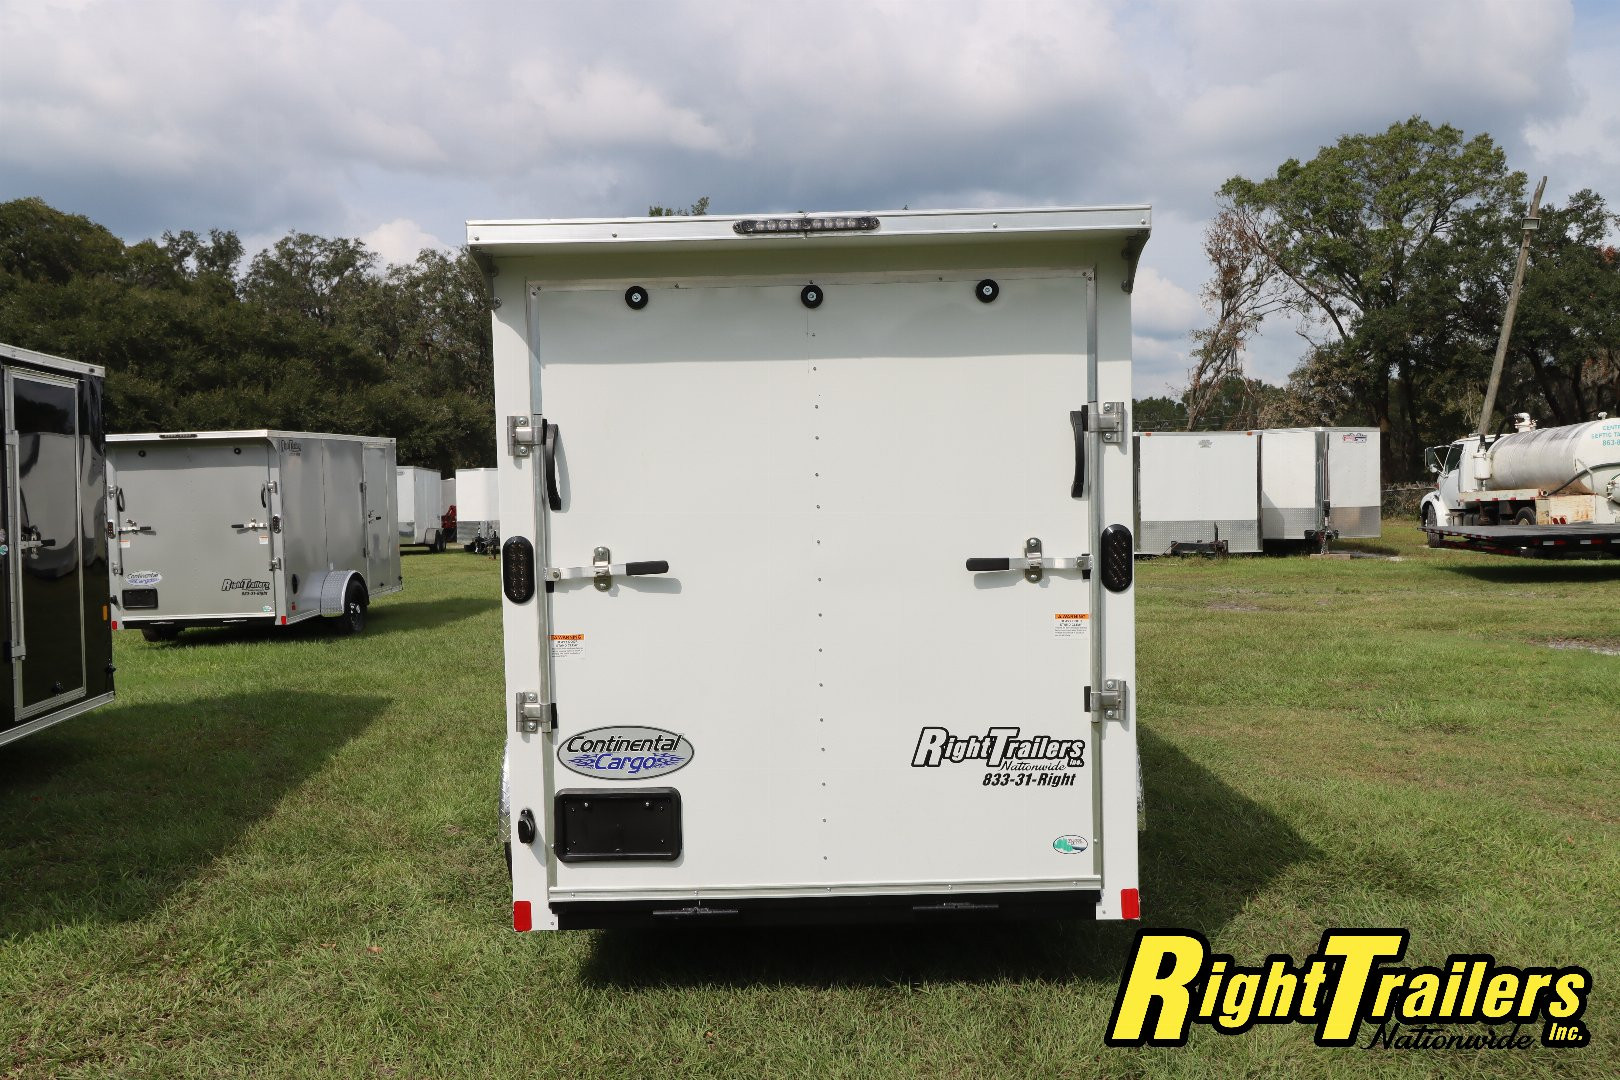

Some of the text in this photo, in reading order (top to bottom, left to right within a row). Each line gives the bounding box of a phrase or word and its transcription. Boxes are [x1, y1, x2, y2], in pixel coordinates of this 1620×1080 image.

[566, 735, 682, 752] Continental
[594, 753, 657, 774] Cargo
[999, 761, 1067, 771] Nationwide
[982, 772, 1077, 787] 833-31-Right
